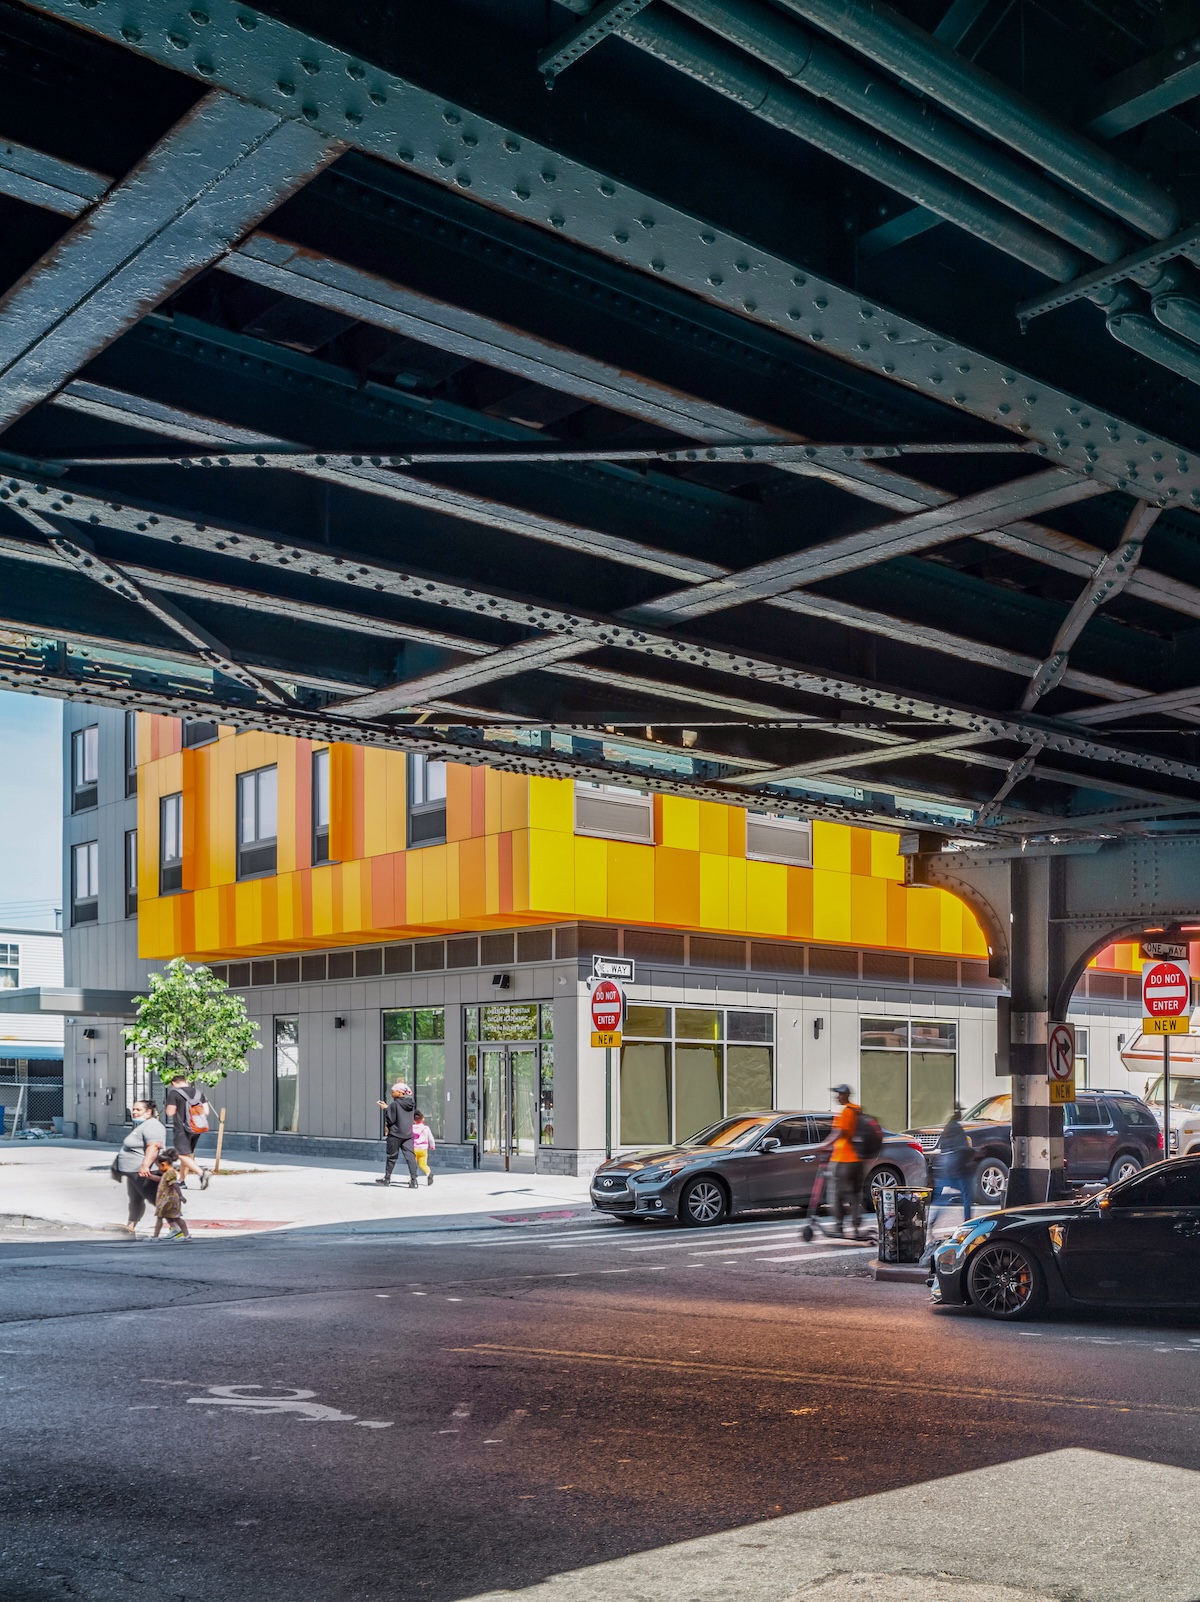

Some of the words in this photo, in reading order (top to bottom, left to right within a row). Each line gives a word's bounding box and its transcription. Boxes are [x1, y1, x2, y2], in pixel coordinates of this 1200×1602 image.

[1146, 943, 1162, 954] ONE
[1168, 946, 1184, 956] WAY
[611, 965, 628, 974] WAY
[1151, 975, 1162, 984] DO
[1165, 974, 1180, 984] NOT
[595, 992, 604, 1000] DO
[605, 991, 616, 1000] NOT
[1153, 1000, 1178, 1010] ENTER
[597, 1015, 616, 1025] ENTER
[1155, 1020, 1177, 1031] NEW
[598, 1034, 614, 1044] NEW
[1055, 1084, 1071, 1099] NEW
